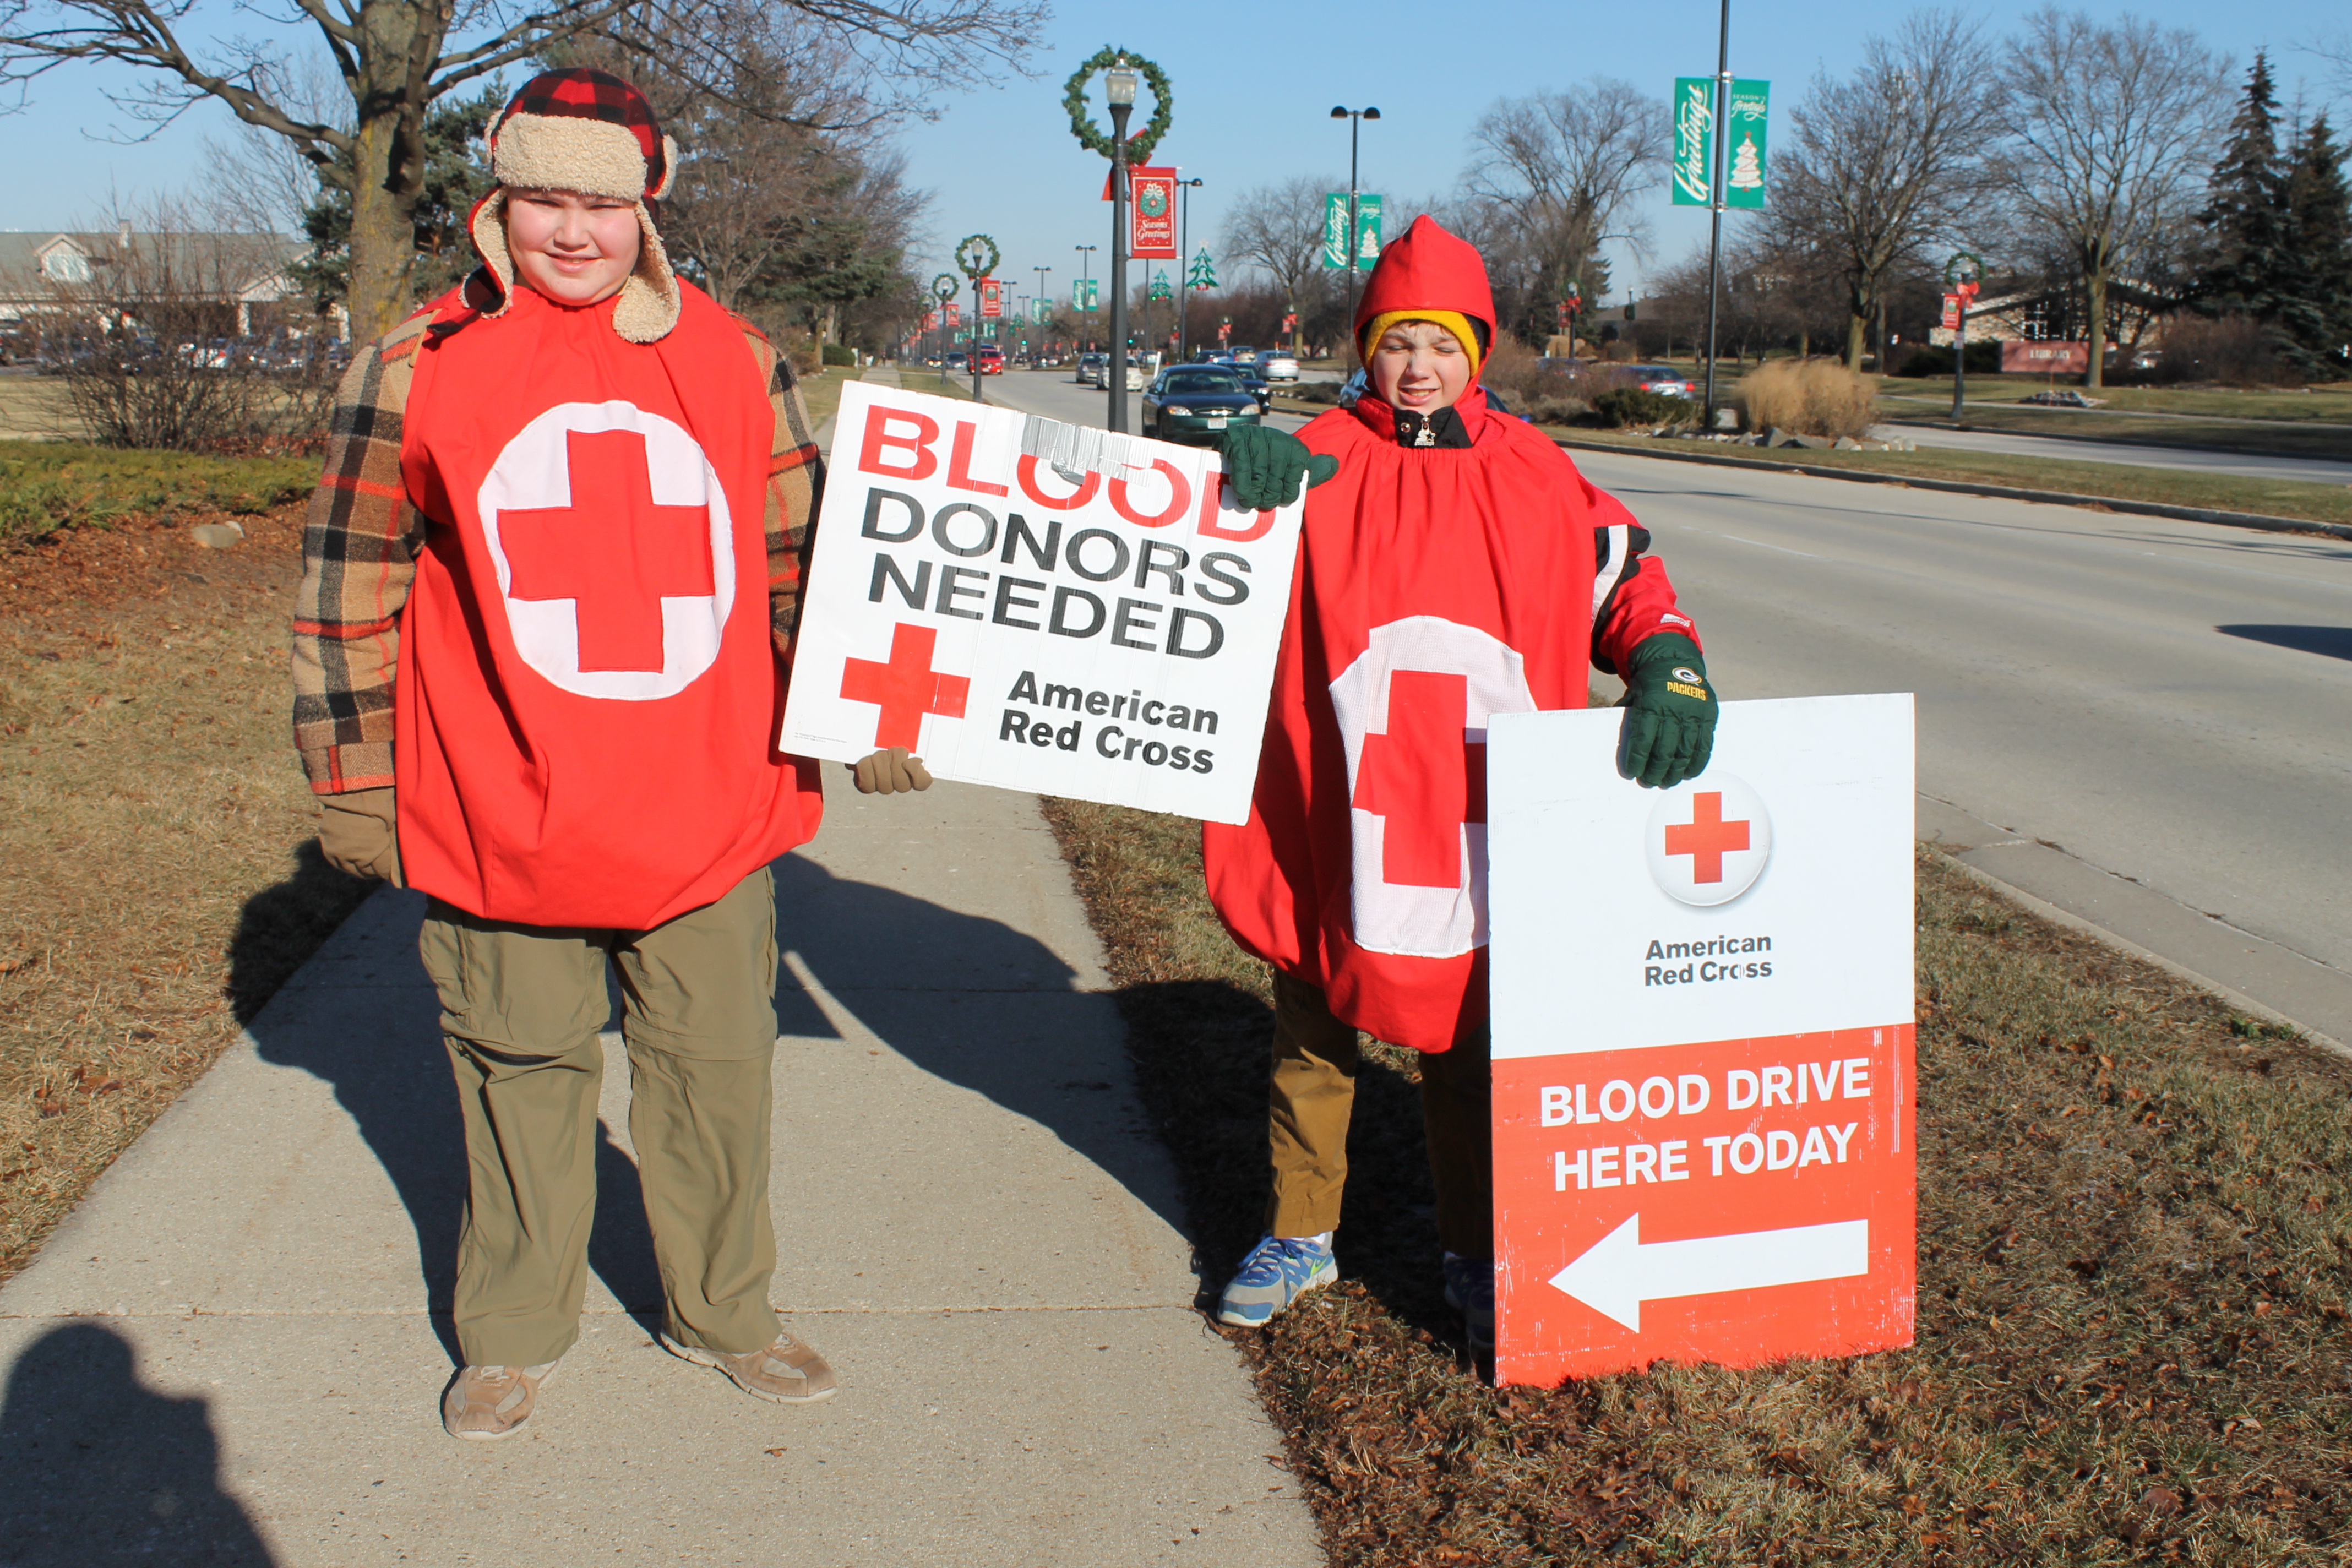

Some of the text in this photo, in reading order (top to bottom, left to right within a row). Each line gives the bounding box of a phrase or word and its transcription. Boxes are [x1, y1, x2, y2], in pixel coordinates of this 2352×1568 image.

[1674, 84, 1712, 202] Greetings
[2029, 349, 2072, 360] LIBRARY
[861, 487, 1253, 605] DONORS
[869, 553, 1224, 659] NEEDED
[1006, 670, 1218, 734] American
[1667, 681, 1707, 701] PACKERS
[999, 708, 1215, 774] Red Cross
[1645, 935, 1772, 960] American
[1645, 961, 1772, 987] Red Cross
[1541, 1057, 1871, 1128] BLOOD DRIVE
[1555, 1121, 1859, 1192] HERE TODAY
